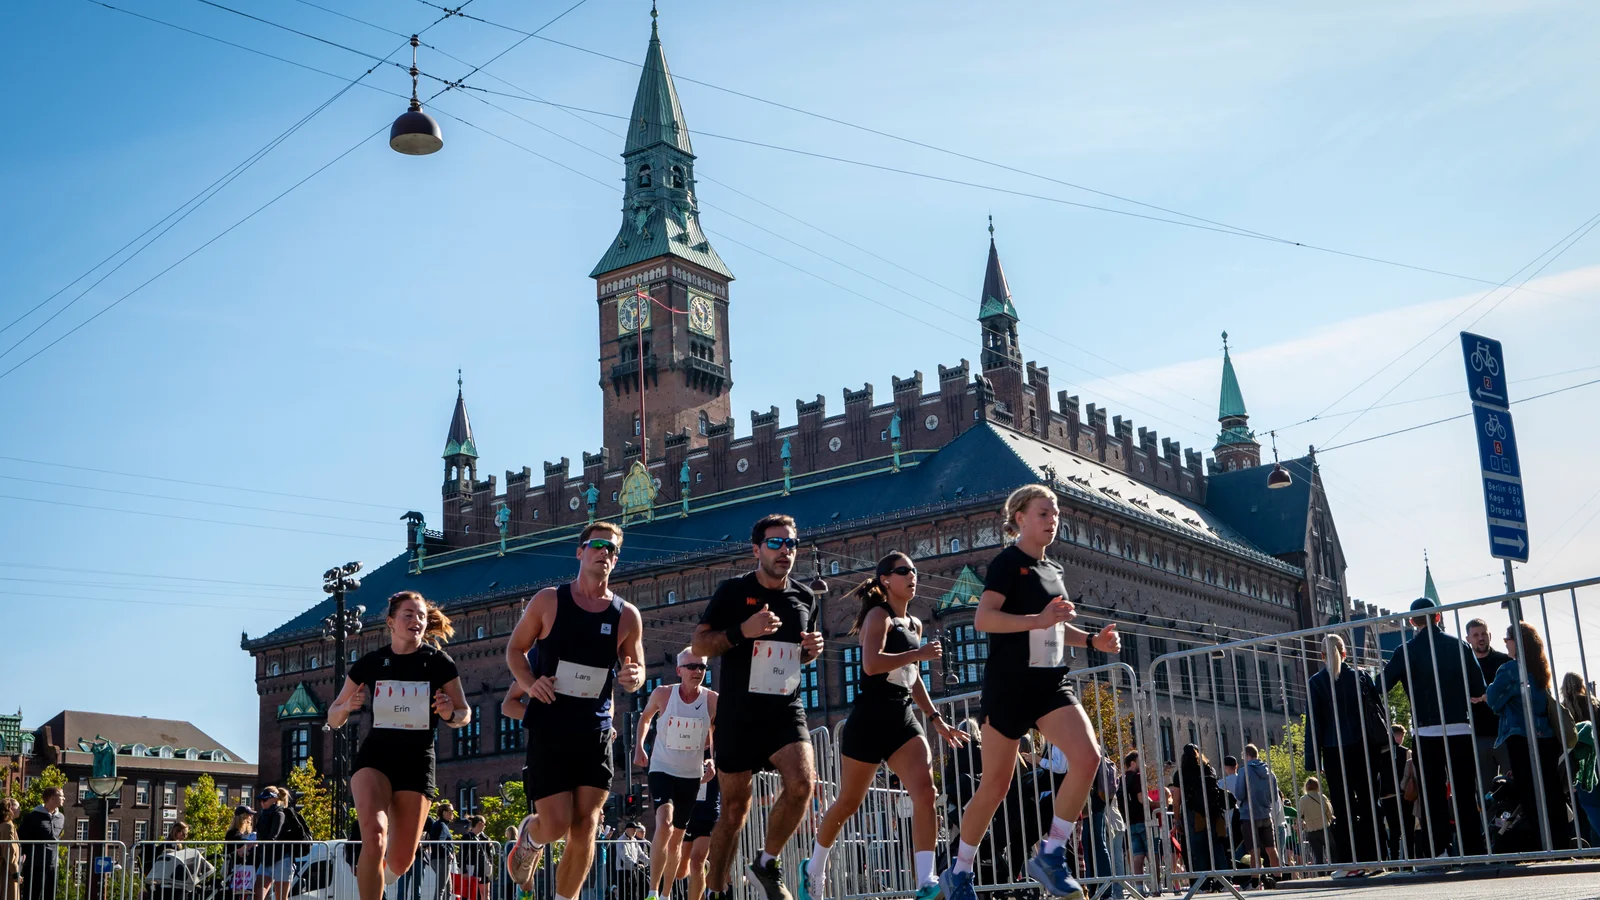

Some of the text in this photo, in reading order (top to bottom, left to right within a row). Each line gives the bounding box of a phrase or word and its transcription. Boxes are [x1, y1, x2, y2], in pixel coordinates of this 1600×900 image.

[1486, 378, 1491, 388] 2
[1496, 443, 1500, 452] 6
[1487, 481, 1520, 496] Berlin 681
[1512, 496, 1521, 506] 59
[1514, 508, 1523, 518] 16
[773, 667, 785, 675] Rui
[575, 672, 591, 681] Lars
[394, 705, 410, 713] Erin
